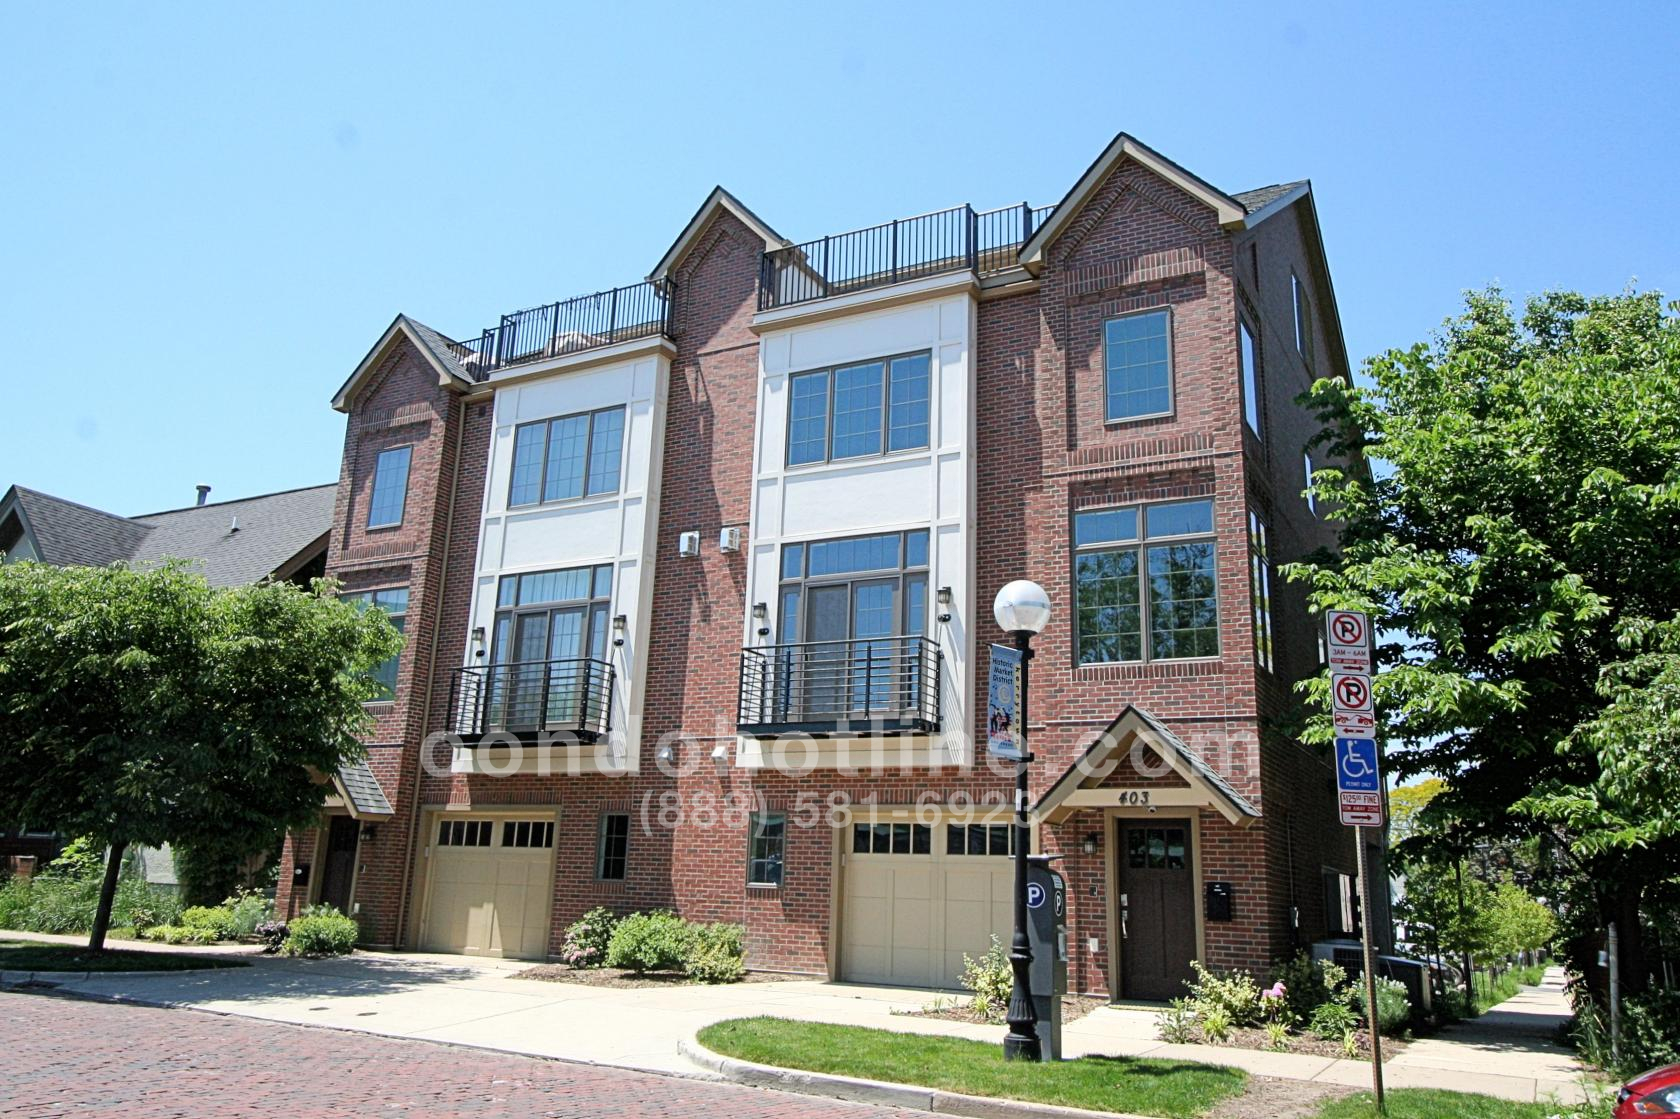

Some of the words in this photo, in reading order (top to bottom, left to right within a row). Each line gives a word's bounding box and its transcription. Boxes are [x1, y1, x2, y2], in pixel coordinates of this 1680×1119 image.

[992, 657, 1014, 669] Historic
[994, 666, 1013, 677] Market
[992, 674, 1014, 685] District
[1118, 791, 1150, 805] 403
[1363, 795, 1377, 804] FINE
[1028, 886, 1040, 904] P
[1056, 894, 1062, 912] P
